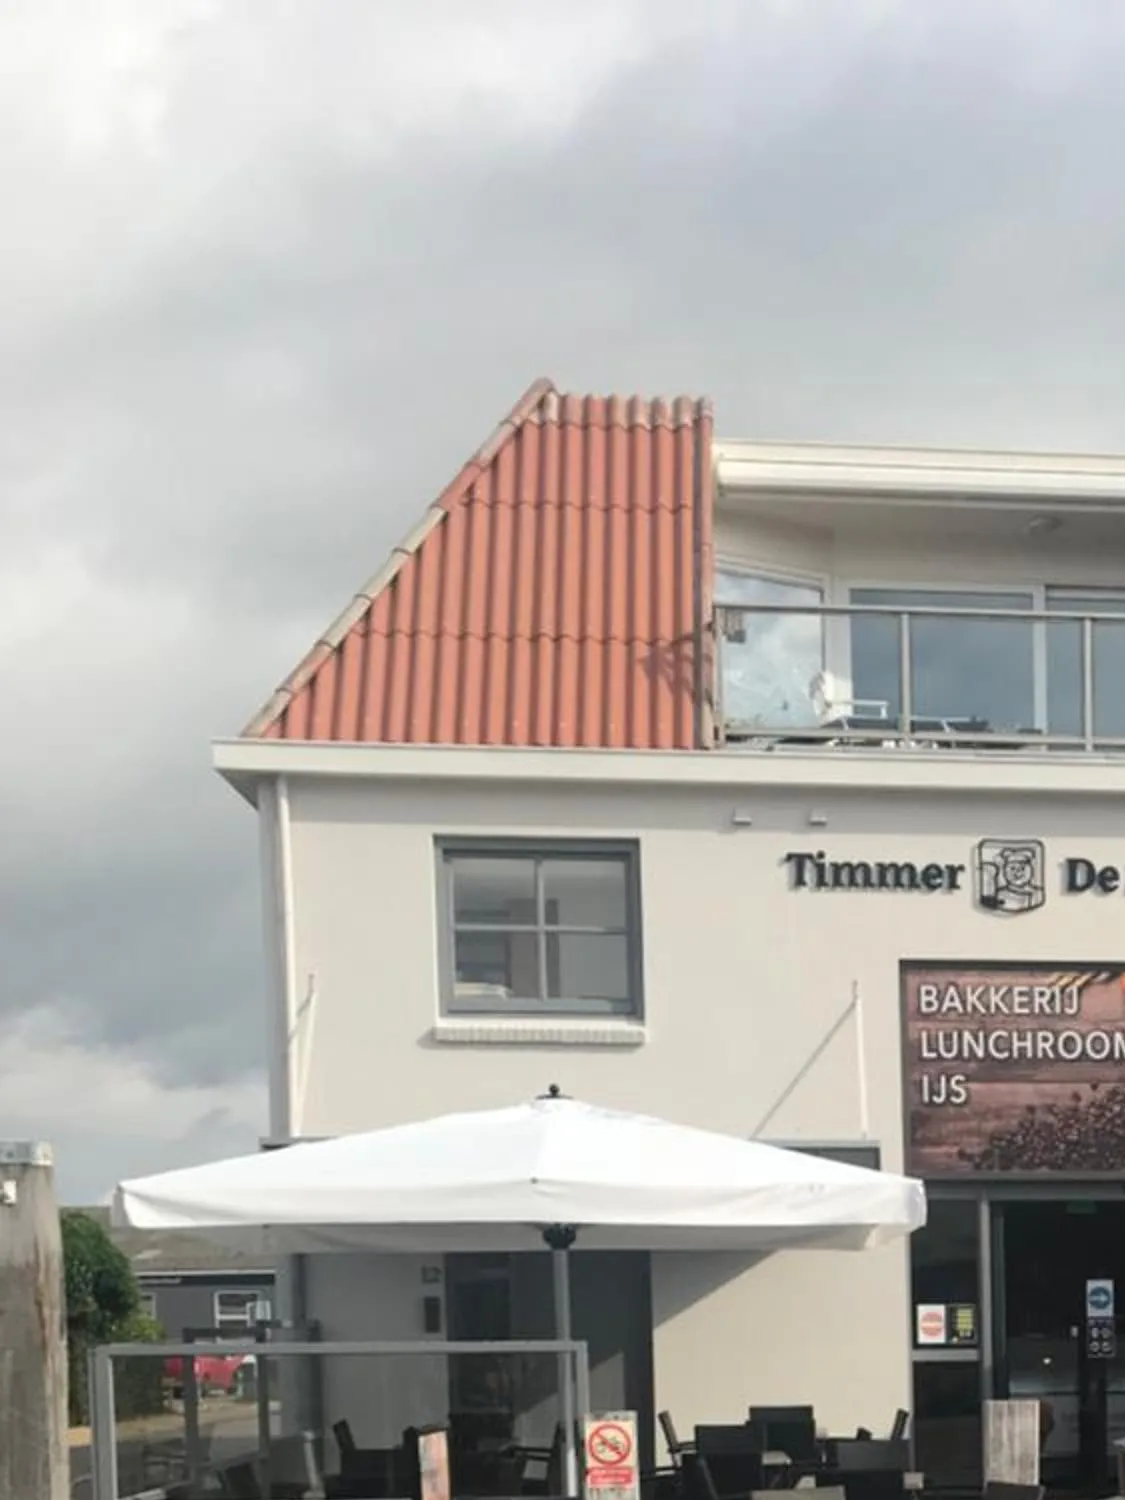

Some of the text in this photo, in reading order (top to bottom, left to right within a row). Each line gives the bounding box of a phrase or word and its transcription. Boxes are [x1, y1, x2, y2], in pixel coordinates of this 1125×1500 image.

[785, 850, 965, 891] Timmer
[1066, 858, 1120, 893] De
[919, 985, 1081, 1015] BAKKERIJ
[921, 1074, 968, 1104] IJS
